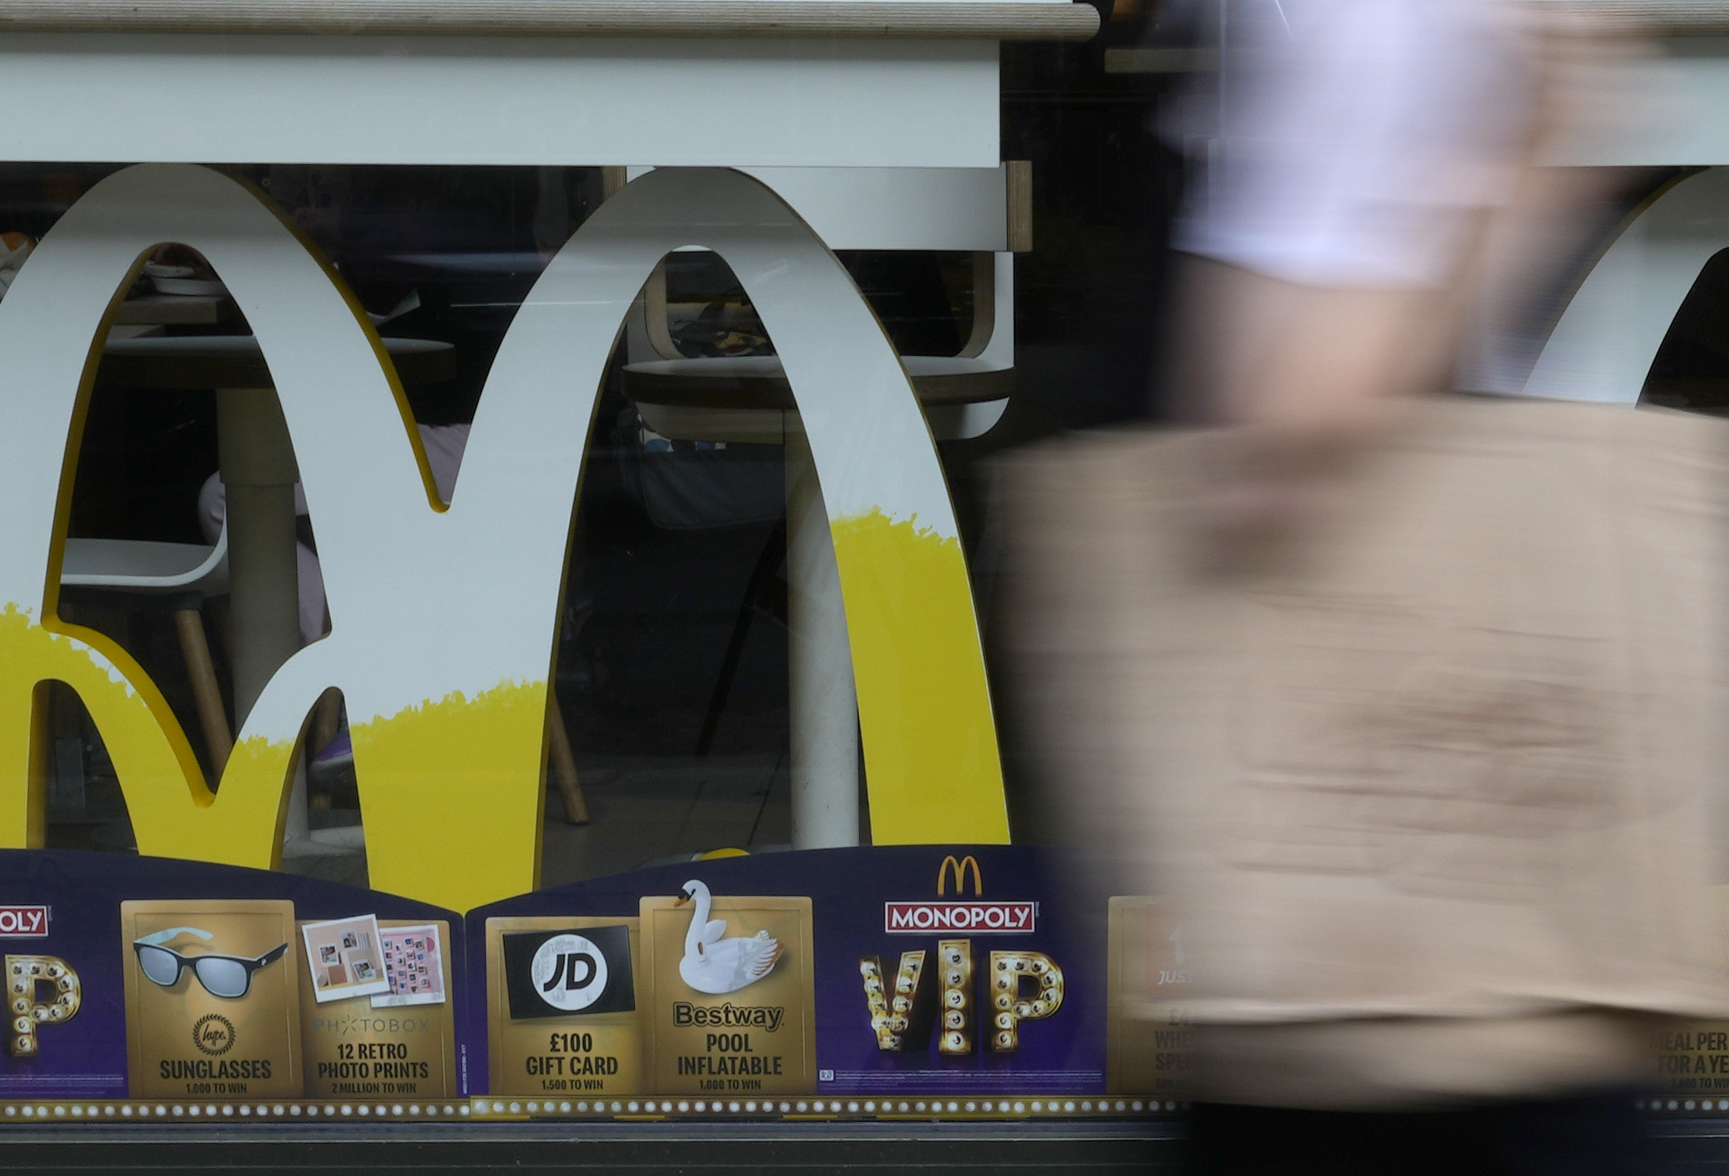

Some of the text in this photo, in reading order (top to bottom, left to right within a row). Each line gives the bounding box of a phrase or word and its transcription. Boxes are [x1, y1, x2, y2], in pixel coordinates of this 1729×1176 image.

[890, 905, 1031, 930] MONOPOLY
[543, 953, 597, 992] JD
[859, 939, 1066, 1056] VIP
[550, 1033, 593, 1053] £100
[706, 1033, 753, 1053] POOL
[1697, 1032, 1728, 1051] PER
[337, 1043, 408, 1060] 12 RETRO
[160, 1060, 272, 1081] SUNGLASSES
[318, 1062, 429, 1079] PHOTO PRINTS
[526, 1056, 619, 1077] GIFT CARD
[678, 1056, 783, 1076] INFLATABLE
[1694, 1055, 1706, 1074] A
[213, 1082, 224, 1094] TO
[226, 1082, 247, 1094] WIN
[332, 1082, 417, 1094] 2 MILLION TO WIN
[569, 1080, 580, 1091] TO
[583, 1080, 604, 1091] WIN
[727, 1079, 738, 1091] TO
[740, 1079, 762, 1091] WIN
[1699, 1078, 1712, 1089] TO
